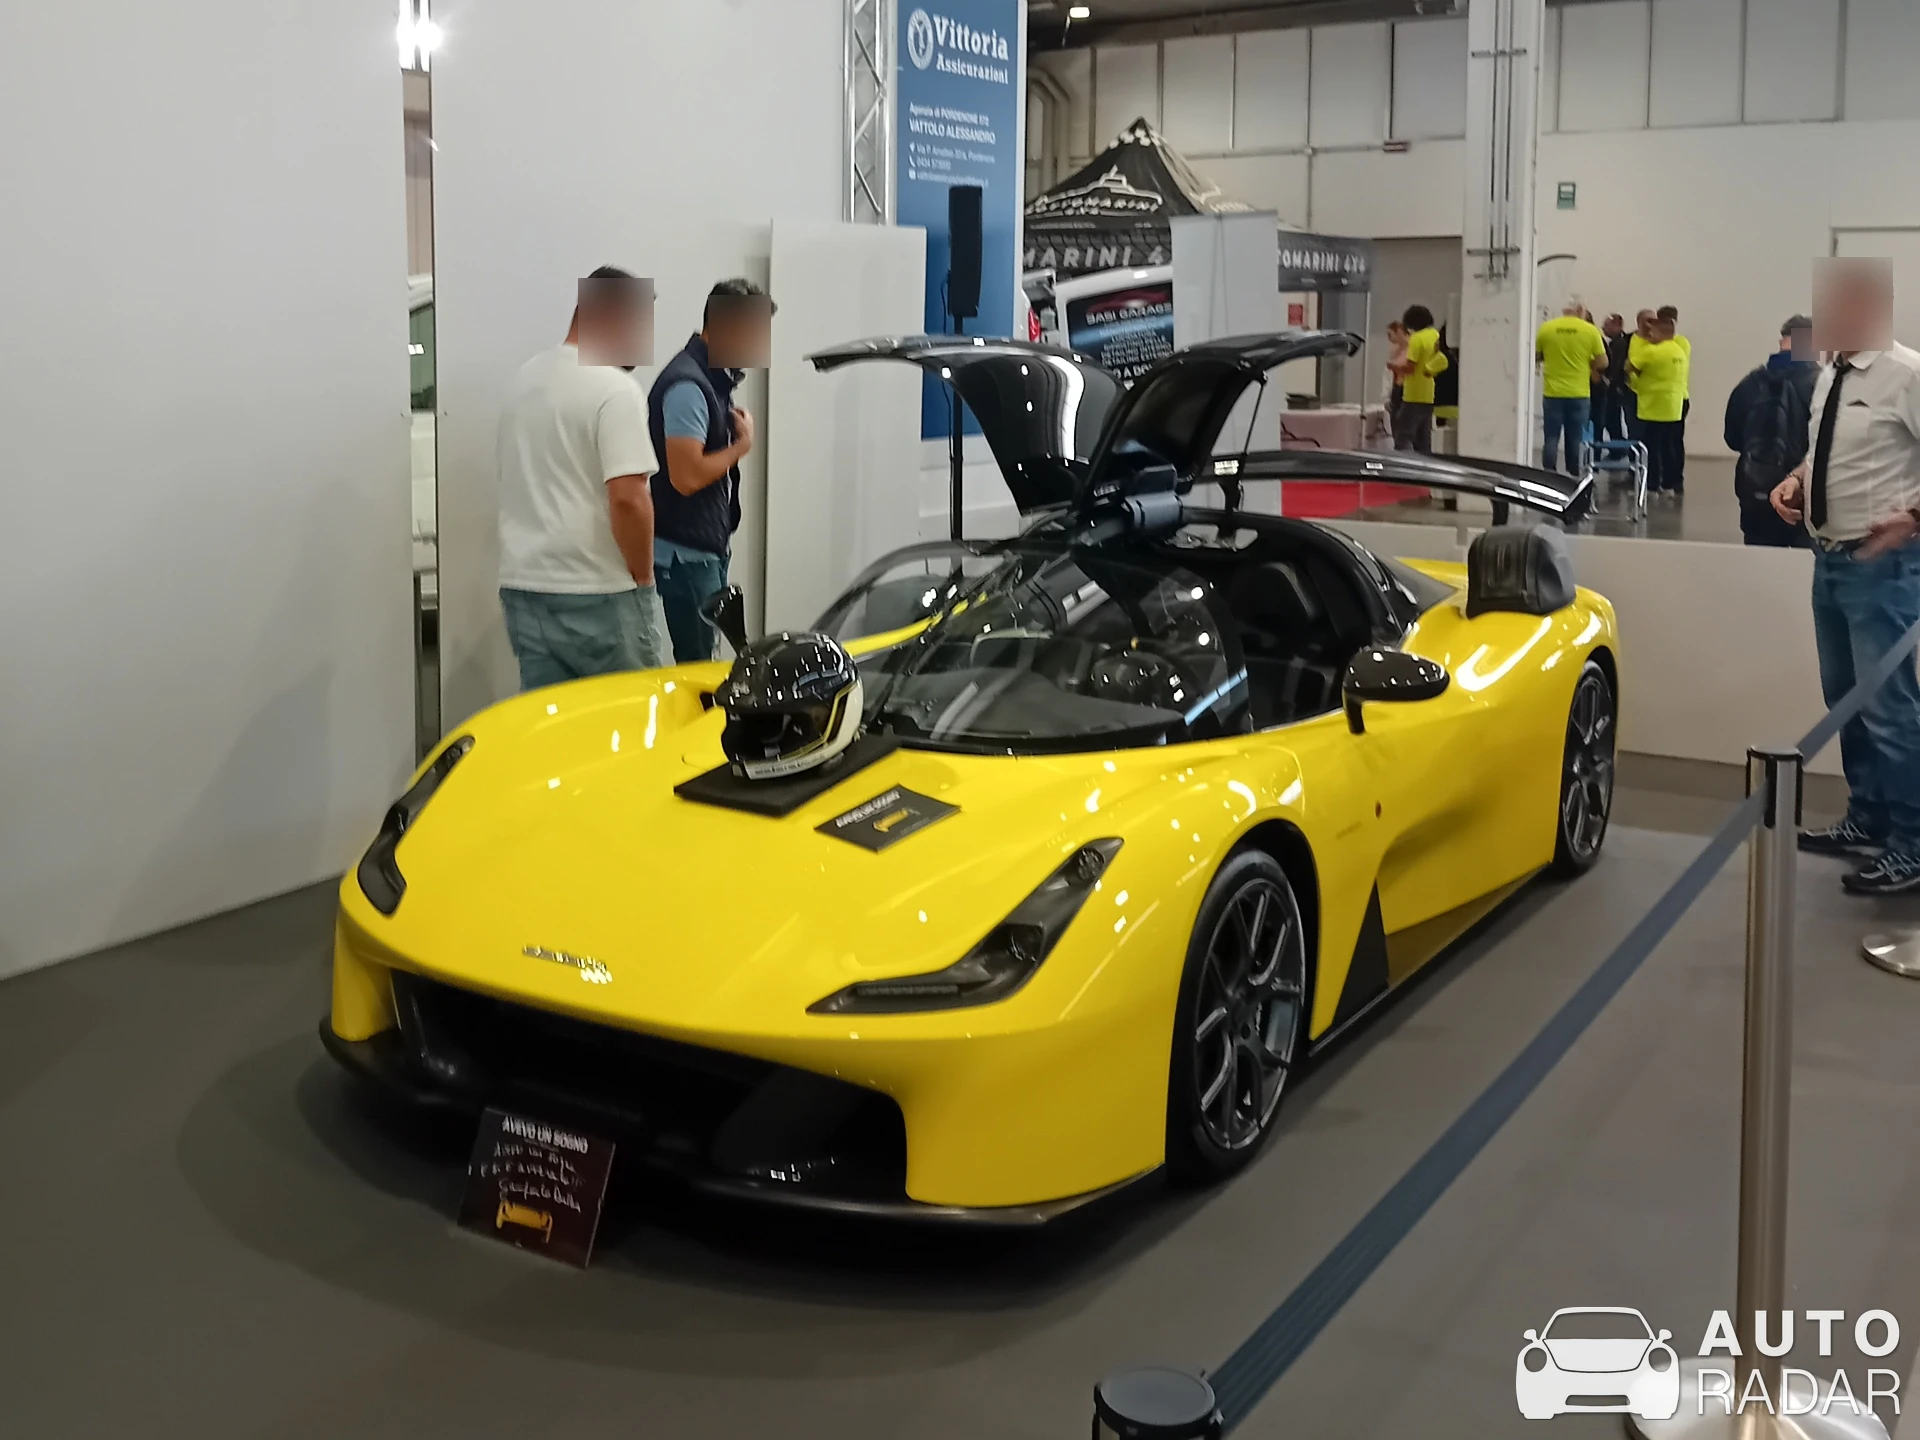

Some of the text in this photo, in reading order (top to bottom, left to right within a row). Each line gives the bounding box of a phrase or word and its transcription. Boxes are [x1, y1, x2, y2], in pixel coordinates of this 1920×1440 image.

[933, 13, 1008, 61] Vittoria
[936, 53, 1008, 85] Assicurazioni
[909, 117, 996, 145] VATTOLO ALESSANDRO
